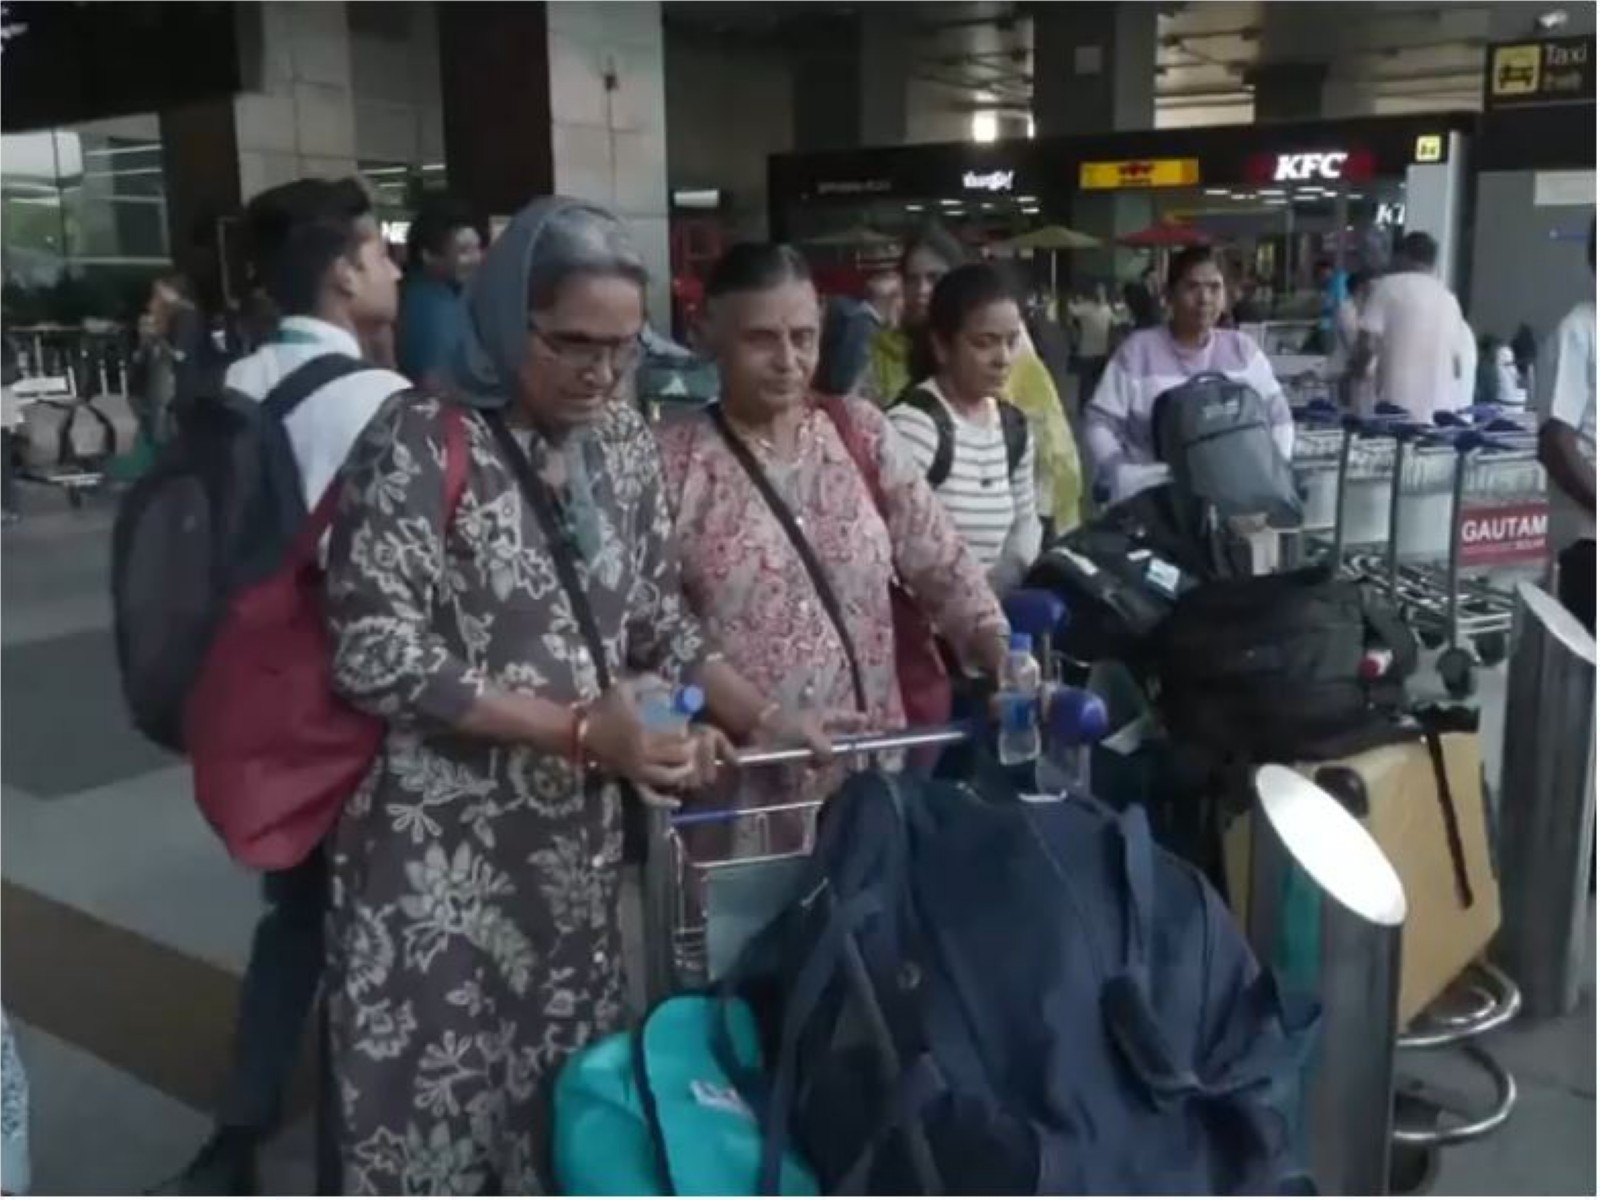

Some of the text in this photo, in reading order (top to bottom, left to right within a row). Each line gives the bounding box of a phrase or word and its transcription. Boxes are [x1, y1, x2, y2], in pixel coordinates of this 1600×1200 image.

[1544, 42, 1587, 66] Taxi
[1274, 152, 1348, 181] KFC
[1461, 513, 1549, 542] GAUTAM
